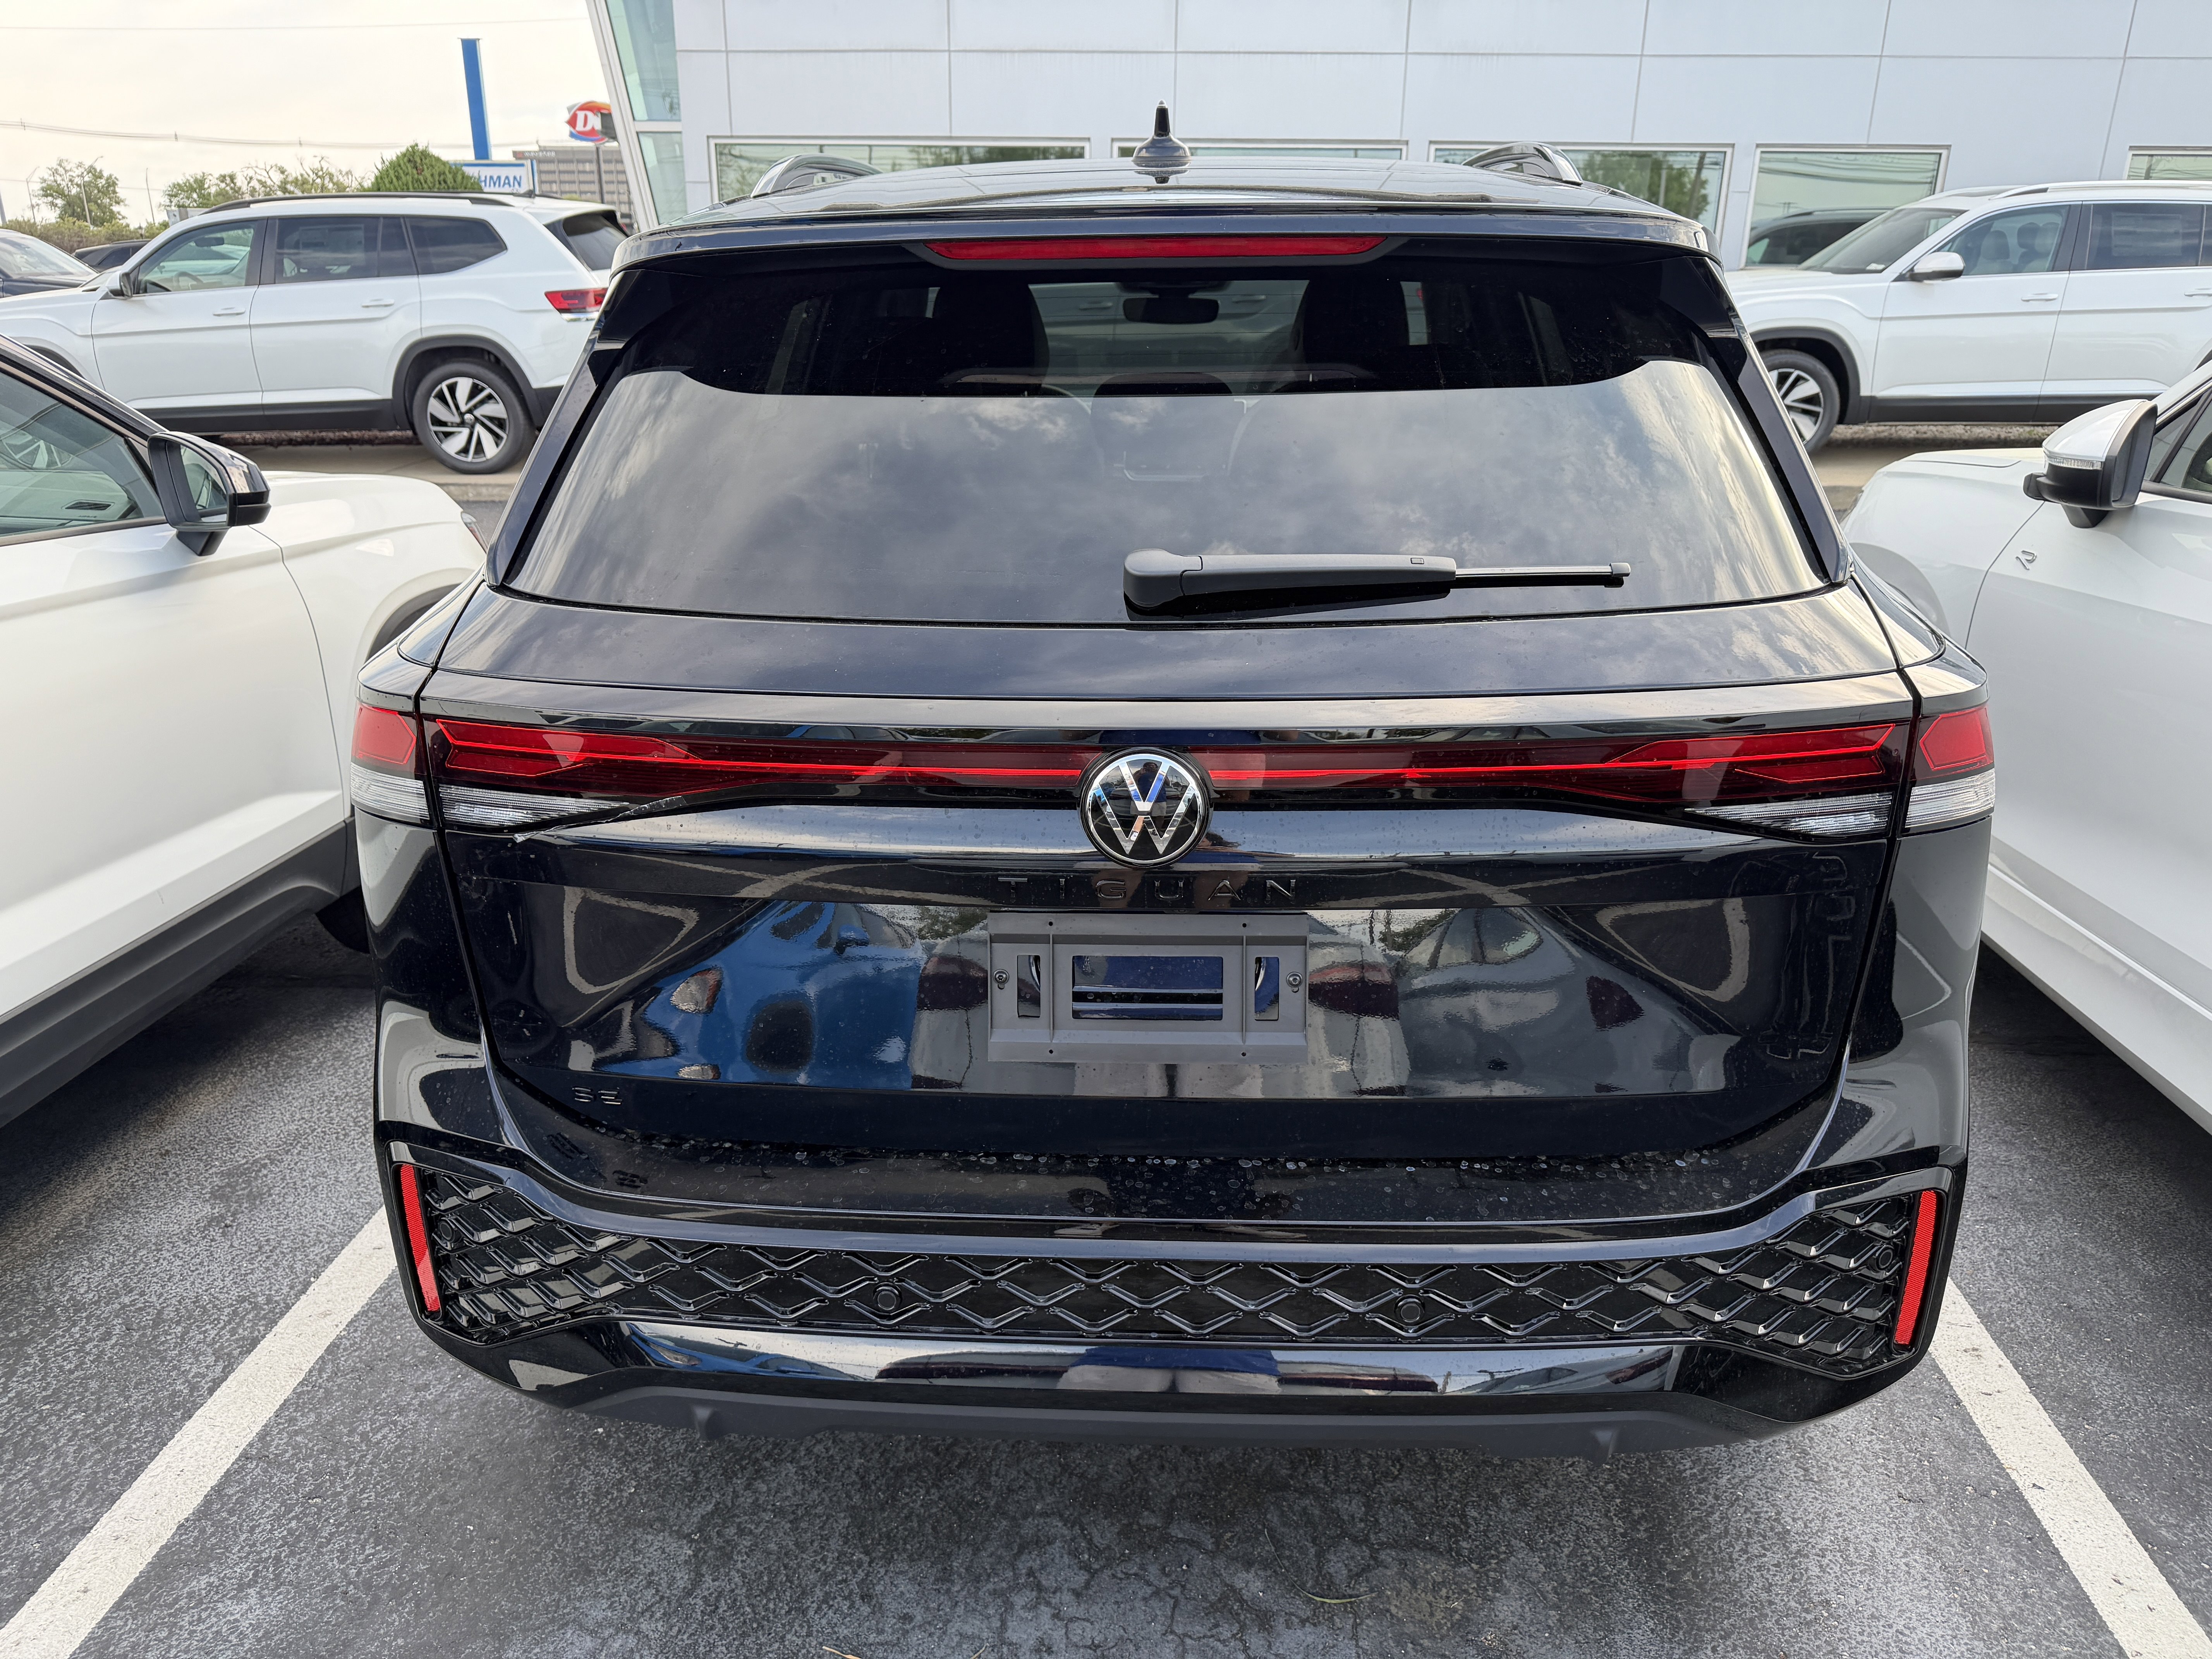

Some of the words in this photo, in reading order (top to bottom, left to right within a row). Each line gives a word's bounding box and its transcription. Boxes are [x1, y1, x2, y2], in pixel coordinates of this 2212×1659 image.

[479, 175, 522, 187] HMAN
[1087, 754, 1203, 864] VW
[998, 877, 1296, 902] TIGUAN
[572, 1086, 622, 1104] SE
